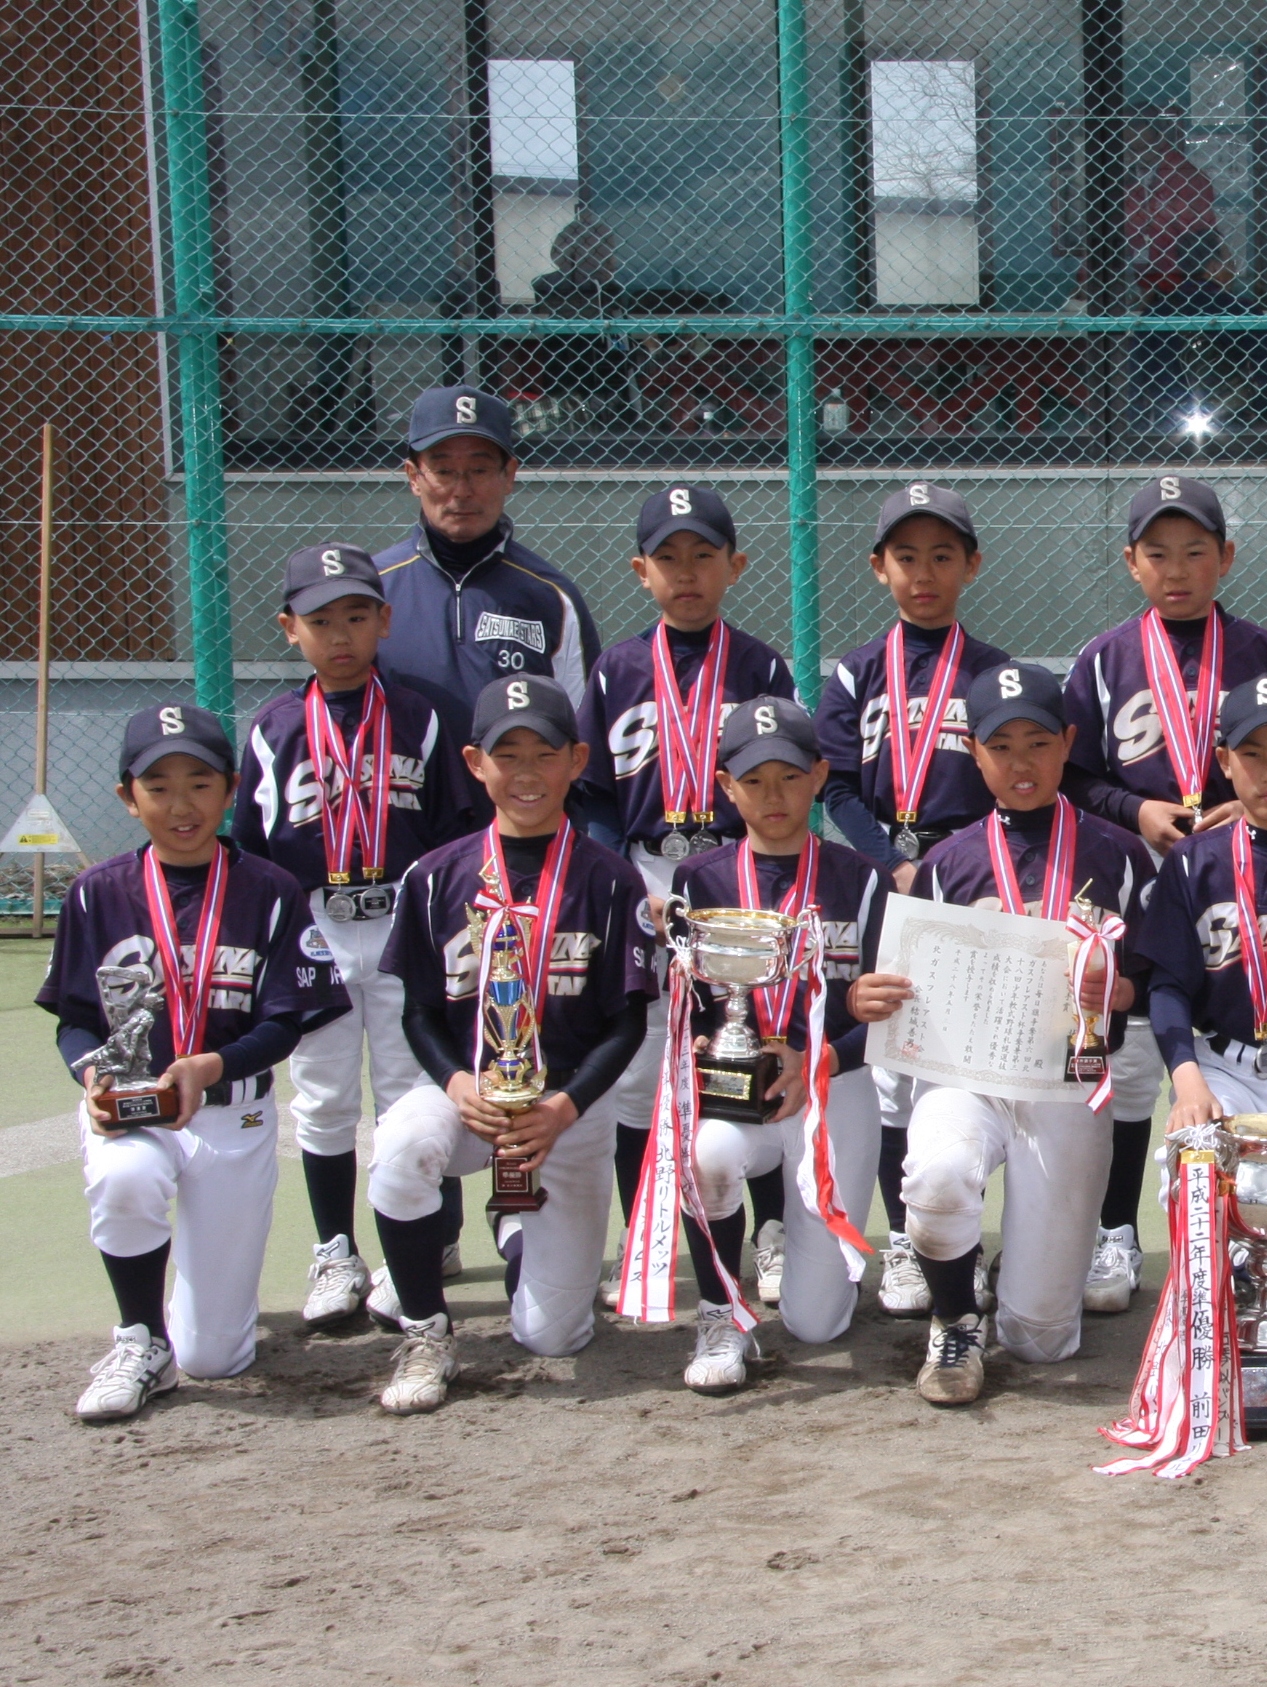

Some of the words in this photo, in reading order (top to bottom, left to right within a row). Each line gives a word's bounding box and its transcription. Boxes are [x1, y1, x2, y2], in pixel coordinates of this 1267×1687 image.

[456, 396, 477, 424] S
[669, 488, 692, 516] S
[908, 484, 930, 507] S
[1159, 476, 1181, 501] S
[322, 550, 344, 577] S
[519, 622, 543, 649] STARS
[497, 650, 525, 670] 30
[507, 681, 530, 710] S
[999, 668, 1023, 699] S
[160, 706, 184, 736] S
[755, 706, 778, 735] S
